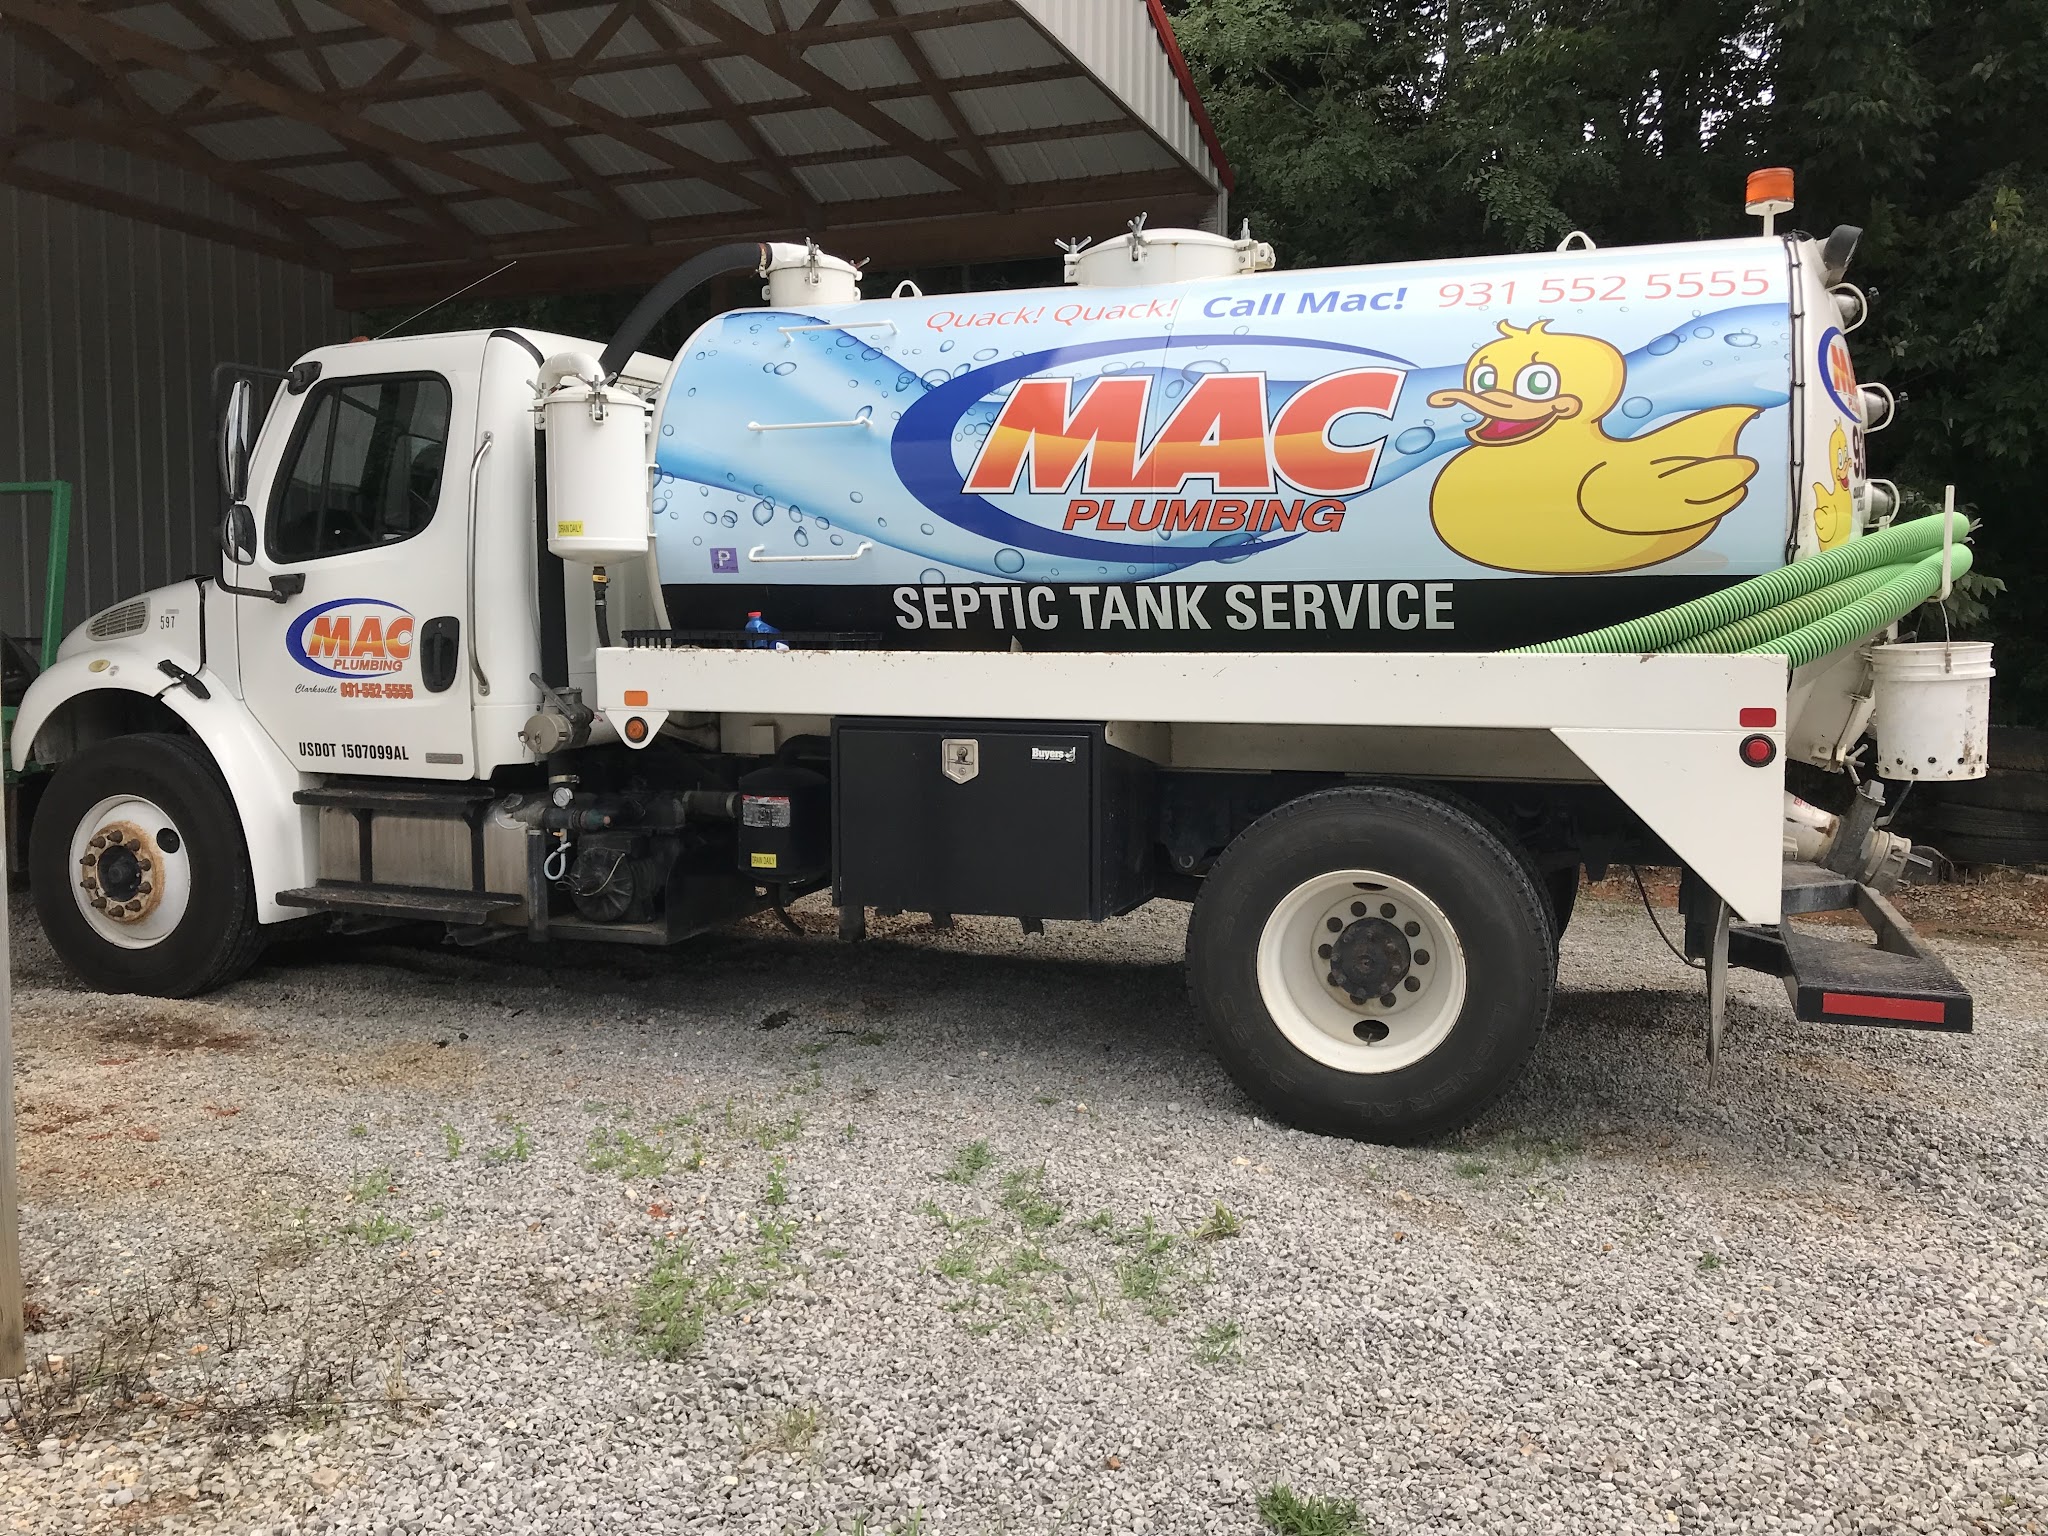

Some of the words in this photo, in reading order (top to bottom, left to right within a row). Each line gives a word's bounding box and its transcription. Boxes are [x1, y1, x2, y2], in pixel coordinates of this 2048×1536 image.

[926, 306, 1046, 333] Quack!
[1053, 298, 1179, 325] Quack!
[1203, 291, 1285, 319] Call
[1296, 287, 1408, 315] Mac!
[1438, 280, 1518, 308] 931
[1538, 275, 1628, 304] 552
[1644, 268, 1770, 300] 5555
[960, 366, 1408, 497] MAC
[1062, 498, 1348, 533] PLUMBING
[893, 585, 1059, 631] SEPTIC
[1069, 584, 1222, 631] TANK
[1226, 582, 1456, 632] SERVICE
[160, 616, 175, 629] 597
[306, 616, 415, 660] MAC
[333, 659, 403, 672] PLUMBING
[295, 683, 338, 694] Clarksville
[340, 682, 413, 699] 931-552-5555
[299, 742, 337, 758] USDOT
[341, 743, 409, 760] 1507099AL
[1031, 747, 1065, 760] Buyers
